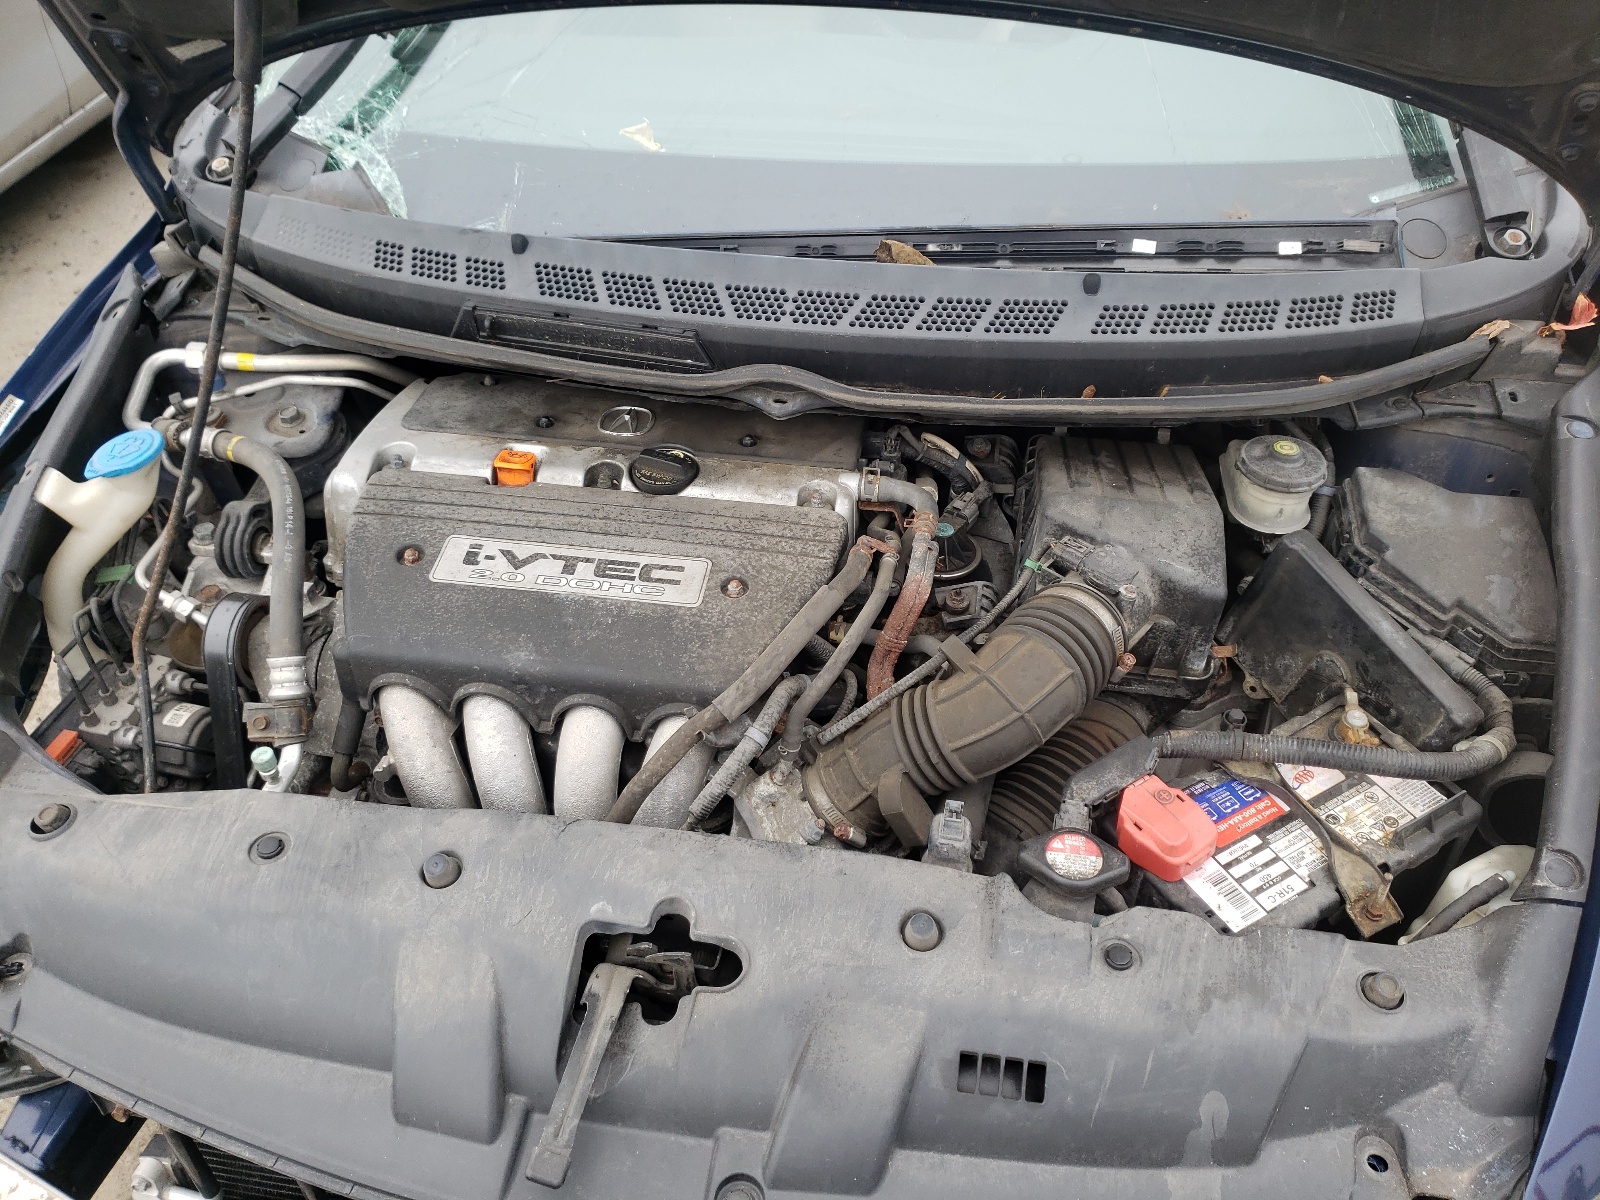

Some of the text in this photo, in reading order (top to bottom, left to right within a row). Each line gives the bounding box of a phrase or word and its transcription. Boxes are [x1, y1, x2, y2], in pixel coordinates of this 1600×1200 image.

[462, 543, 686, 585] i-VTEC
[469, 569, 666, 597] 2.0 DOHC
[1293, 768, 1315, 785] AAA
[1255, 799, 1271, 810] Call:
[1262, 806, 1278, 818] Need
[1259, 873, 1272, 882] 450
[1267, 884, 1294, 904] 51R-C
